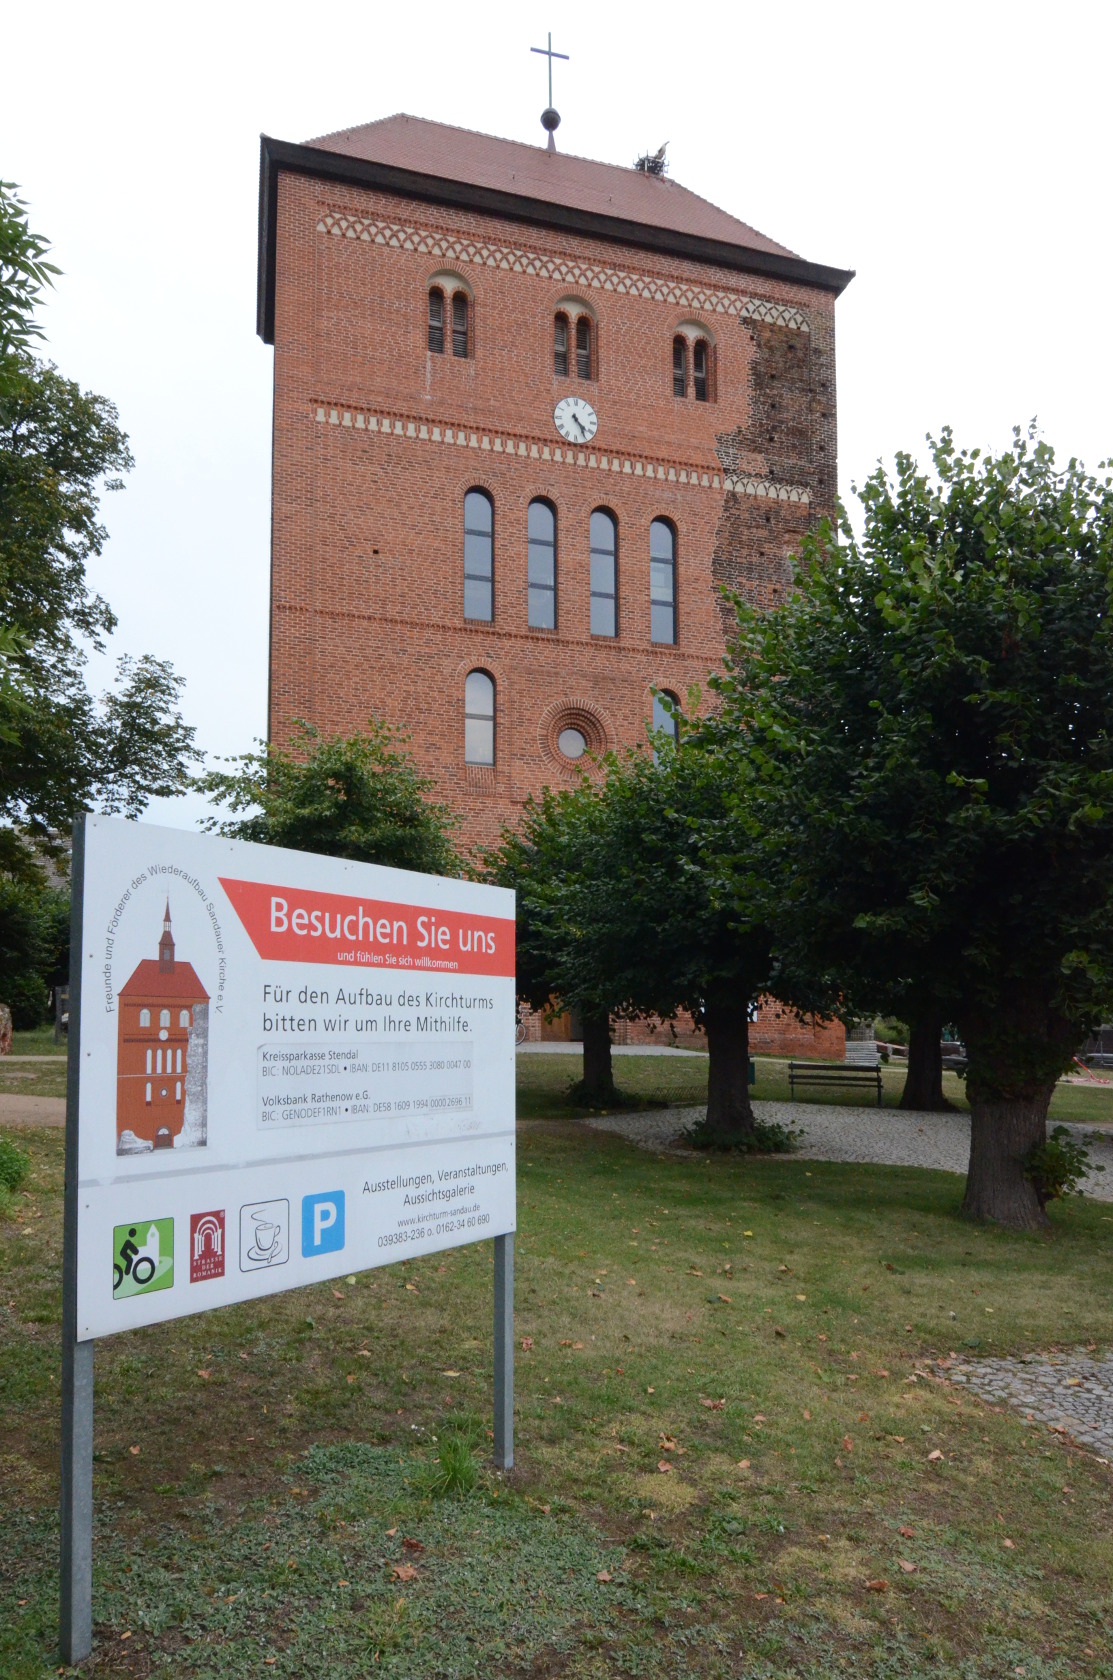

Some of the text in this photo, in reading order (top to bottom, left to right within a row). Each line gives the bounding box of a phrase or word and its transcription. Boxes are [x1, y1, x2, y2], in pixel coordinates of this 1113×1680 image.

[131, 873, 147, 890] des
[148, 864, 208, 902] Wiederaufbau
[108, 889, 132, 935] Förderer
[206, 902, 224, 953] Sandauer
[270, 896, 495, 954] Besuchen Sie uns
[105, 938, 115, 960] und
[338, 950, 458, 969] und fühlen Sie sich willkommen
[102, 964, 115, 1013] Freunde
[263, 985, 493, 1009] Für den Aufbau des Kirchturms
[263, 1012, 472, 1032] bitten wir um Ihre Mithilfe.
[262, 1050, 358, 1063] Kreissparkasse Stendal
[262, 1066, 279, 1076] BIC:
[282, 1064, 341, 1076] NOLADE21SDL
[349, 1062, 369, 1073] IBAN:
[372, 1062, 390, 1072] DE11
[392, 1062, 409, 1071] 8105
[411, 1061, 427, 1071] 0555
[463, 1060, 471, 1068] 00
[262, 1090, 371, 1106] Volksbank Rathenow e.G.
[262, 1110, 279, 1121] BIC:
[282, 1106, 341, 1120] GENODEF1RN1
[351, 1104, 371, 1114] IBAN:
[373, 1102, 391, 1112] DE58
[394, 1100, 410, 1110] 1609
[413, 1099, 428, 1109] 1994
[362, 1162, 508, 1194] Ausstellungen, Veranstaltungen,
[403, 1183, 475, 1207] Aussichtsgalerie
[314, 1202, 337, 1246] P
[398, 1203, 480, 1227] www.kirchturm-sandau.de
[377, 1213, 490, 1248] 039383-236 o. 0162-34 60 690
[193, 1256, 223, 1267] STRASSE
[193, 1268, 222, 1278] ROMANIK
